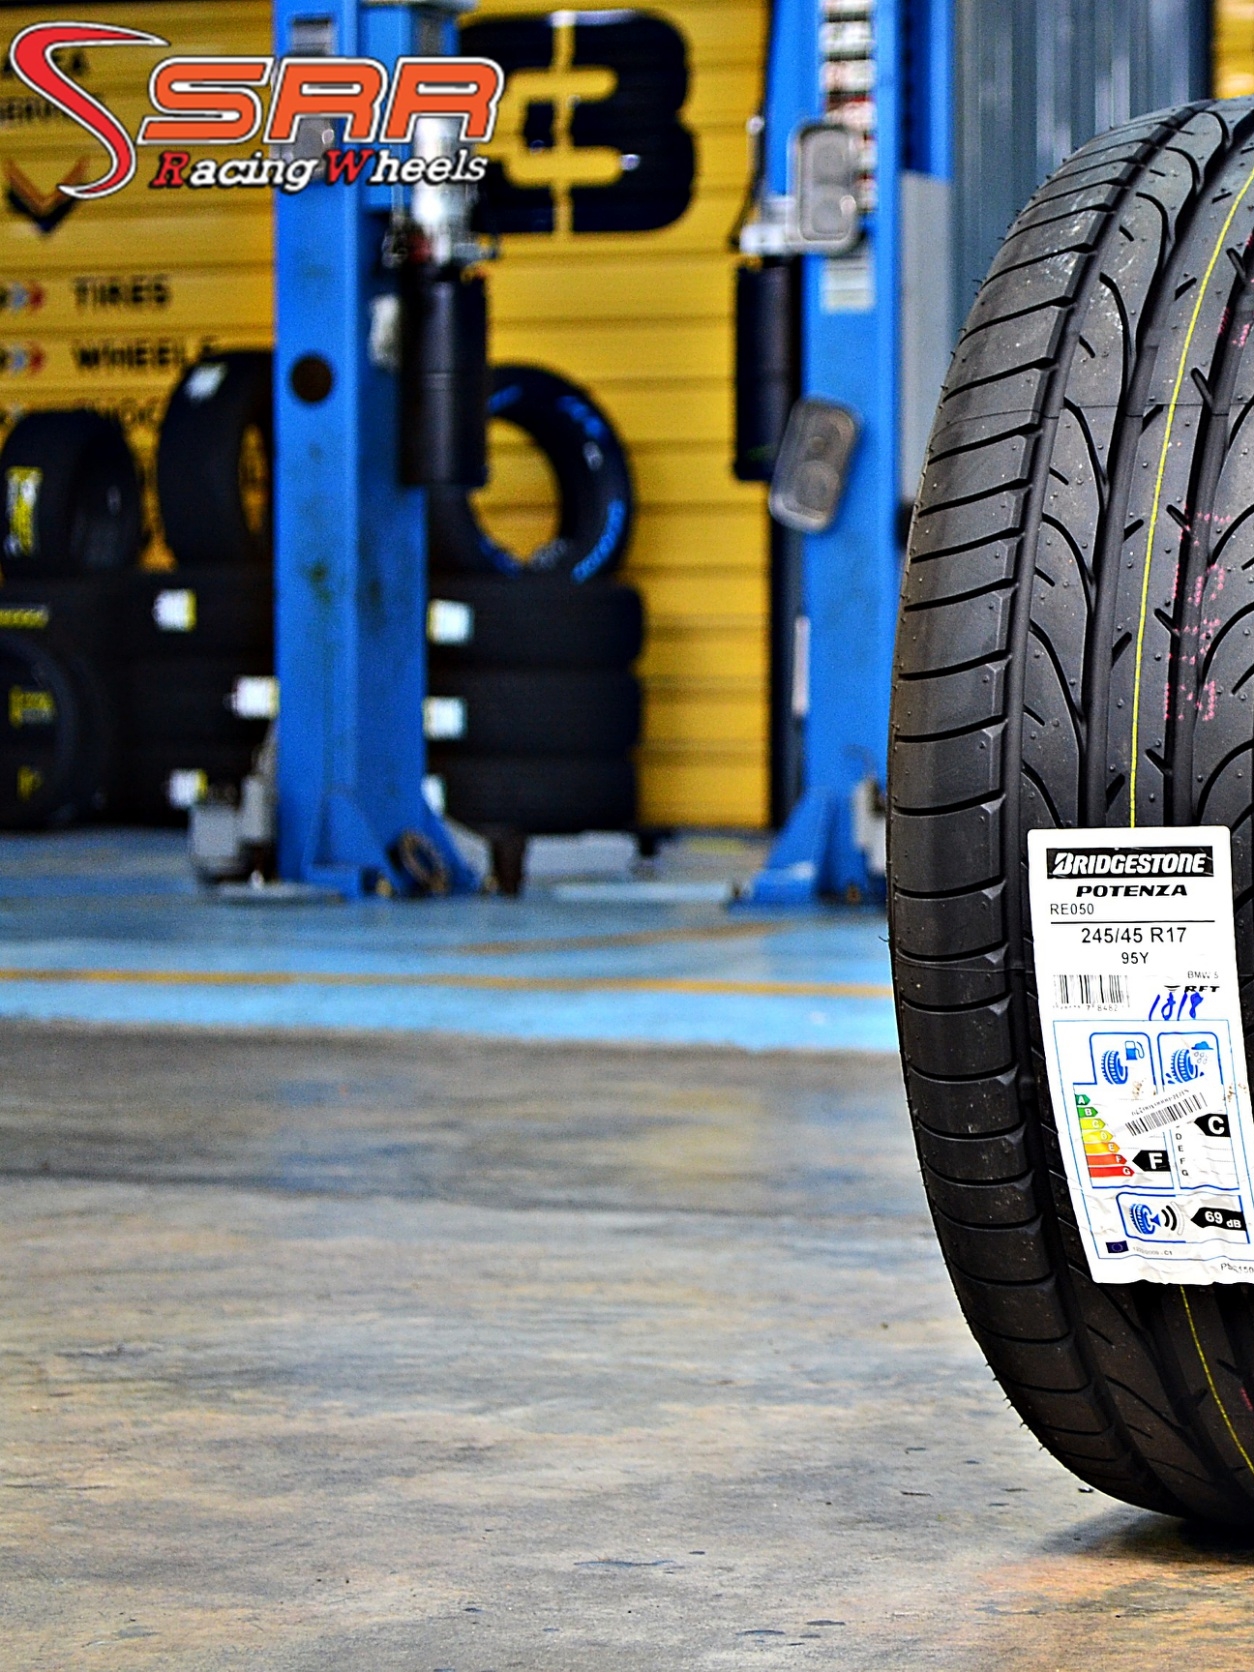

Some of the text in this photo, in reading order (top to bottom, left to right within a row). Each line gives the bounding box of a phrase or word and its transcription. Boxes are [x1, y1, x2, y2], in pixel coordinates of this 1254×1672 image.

[75, 276, 170, 309] TIRES
[1053, 852, 1207, 876] BRIDGESTONE
[1076, 884, 1188, 898] POTENZA
[1050, 903, 1095, 915] RE050
[1081, 926, 1187, 944] 245/45 R17
[1121, 951, 1149, 964] 95Y
[1184, 985, 1221, 993] RFT
[1078, 1095, 1086, 1105] A
[1084, 1108, 1093, 1117] B
[1092, 1120, 1100, 1129] C
[1208, 1115, 1225, 1135] C
[1108, 1144, 1116, 1153] E
[1115, 1156, 1122, 1164] F
[1148, 1152, 1163, 1170] F
[1122, 1168, 1131, 1176] G
[1204, 1210, 1242, 1228] 69 dB
